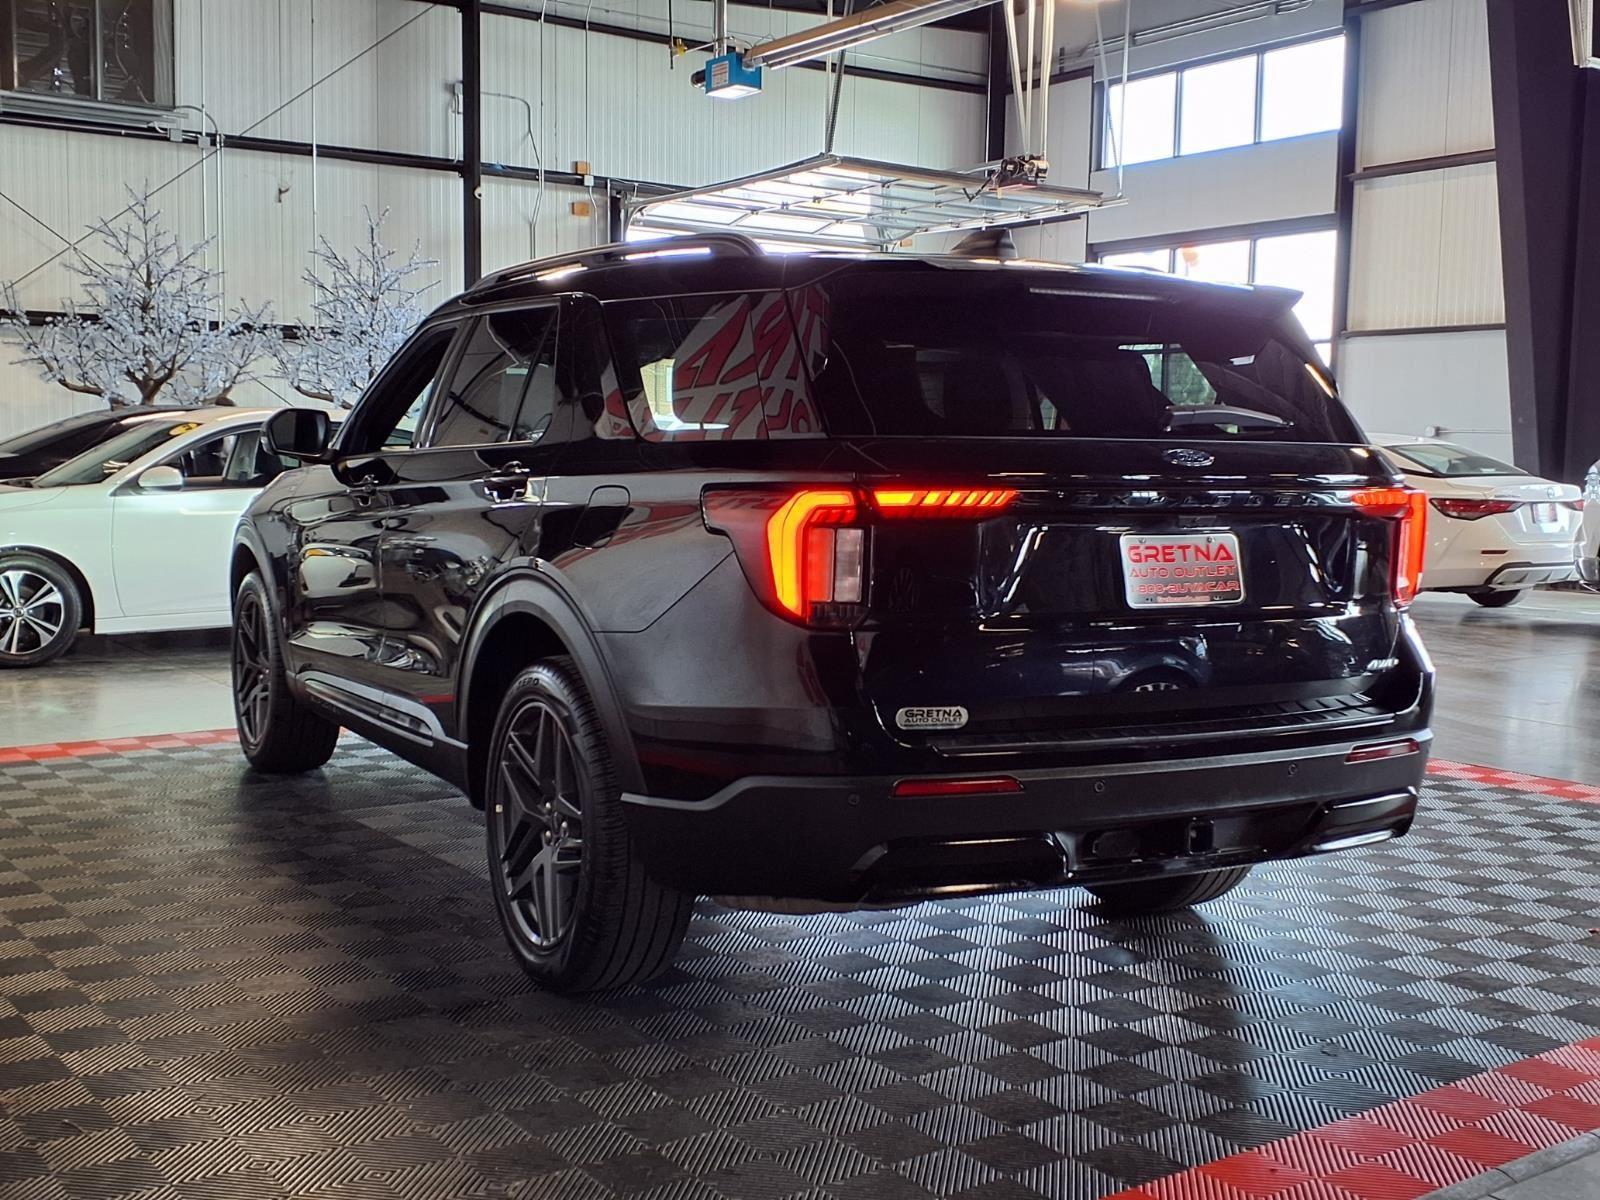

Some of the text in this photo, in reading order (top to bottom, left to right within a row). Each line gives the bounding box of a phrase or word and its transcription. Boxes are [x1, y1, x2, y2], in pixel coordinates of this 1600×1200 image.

[1128, 543, 1235, 564] GRETNA
[1130, 564, 1237, 578] AUTO OUTLET
[904, 709, 963, 718] GRETNA
